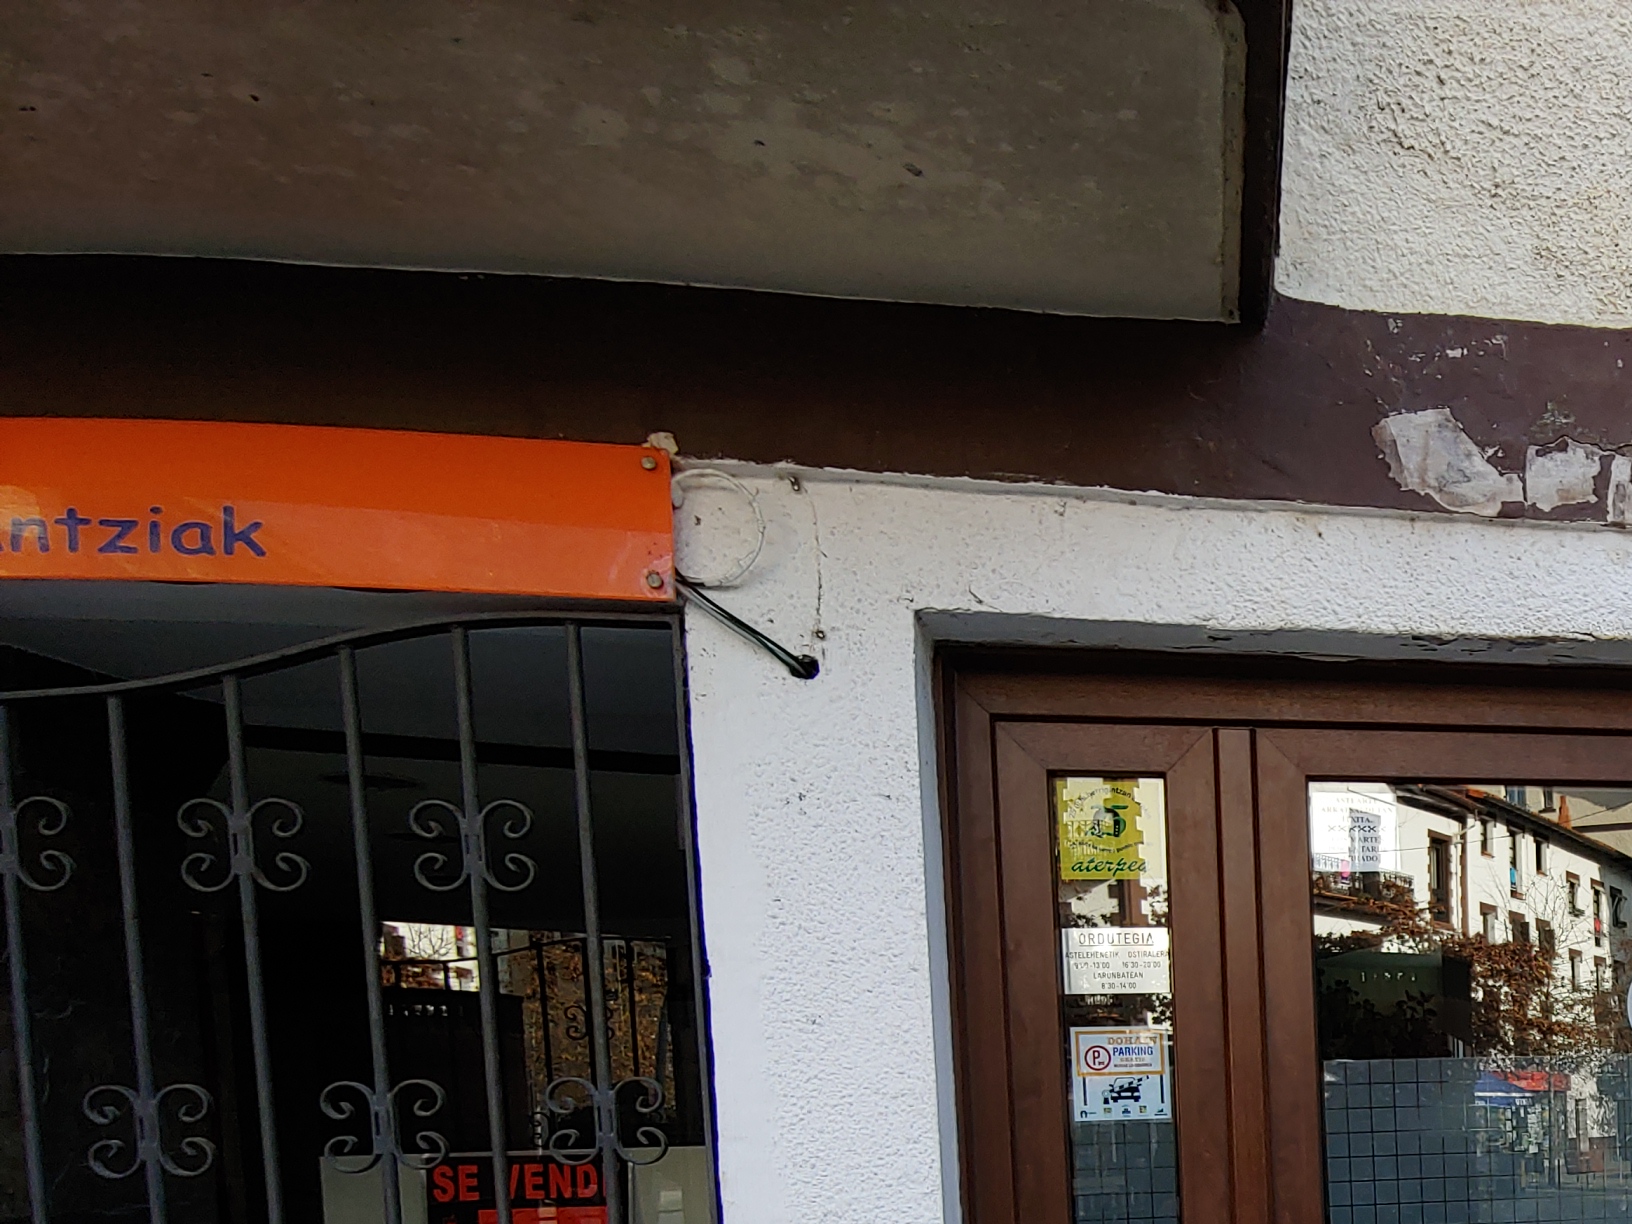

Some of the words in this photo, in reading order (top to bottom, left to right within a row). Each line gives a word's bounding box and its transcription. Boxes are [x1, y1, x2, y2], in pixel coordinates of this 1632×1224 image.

[0, 505, 267, 558] ntziak
[1078, 932, 1155, 944] ORDUTEGIA
[1093, 971, 1145, 979] LARUNBATEAN
[1112, 1046, 1154, 1056] PARKING
[433, 1164, 480, 1203] SE
[508, 1164, 607, 1200] END
